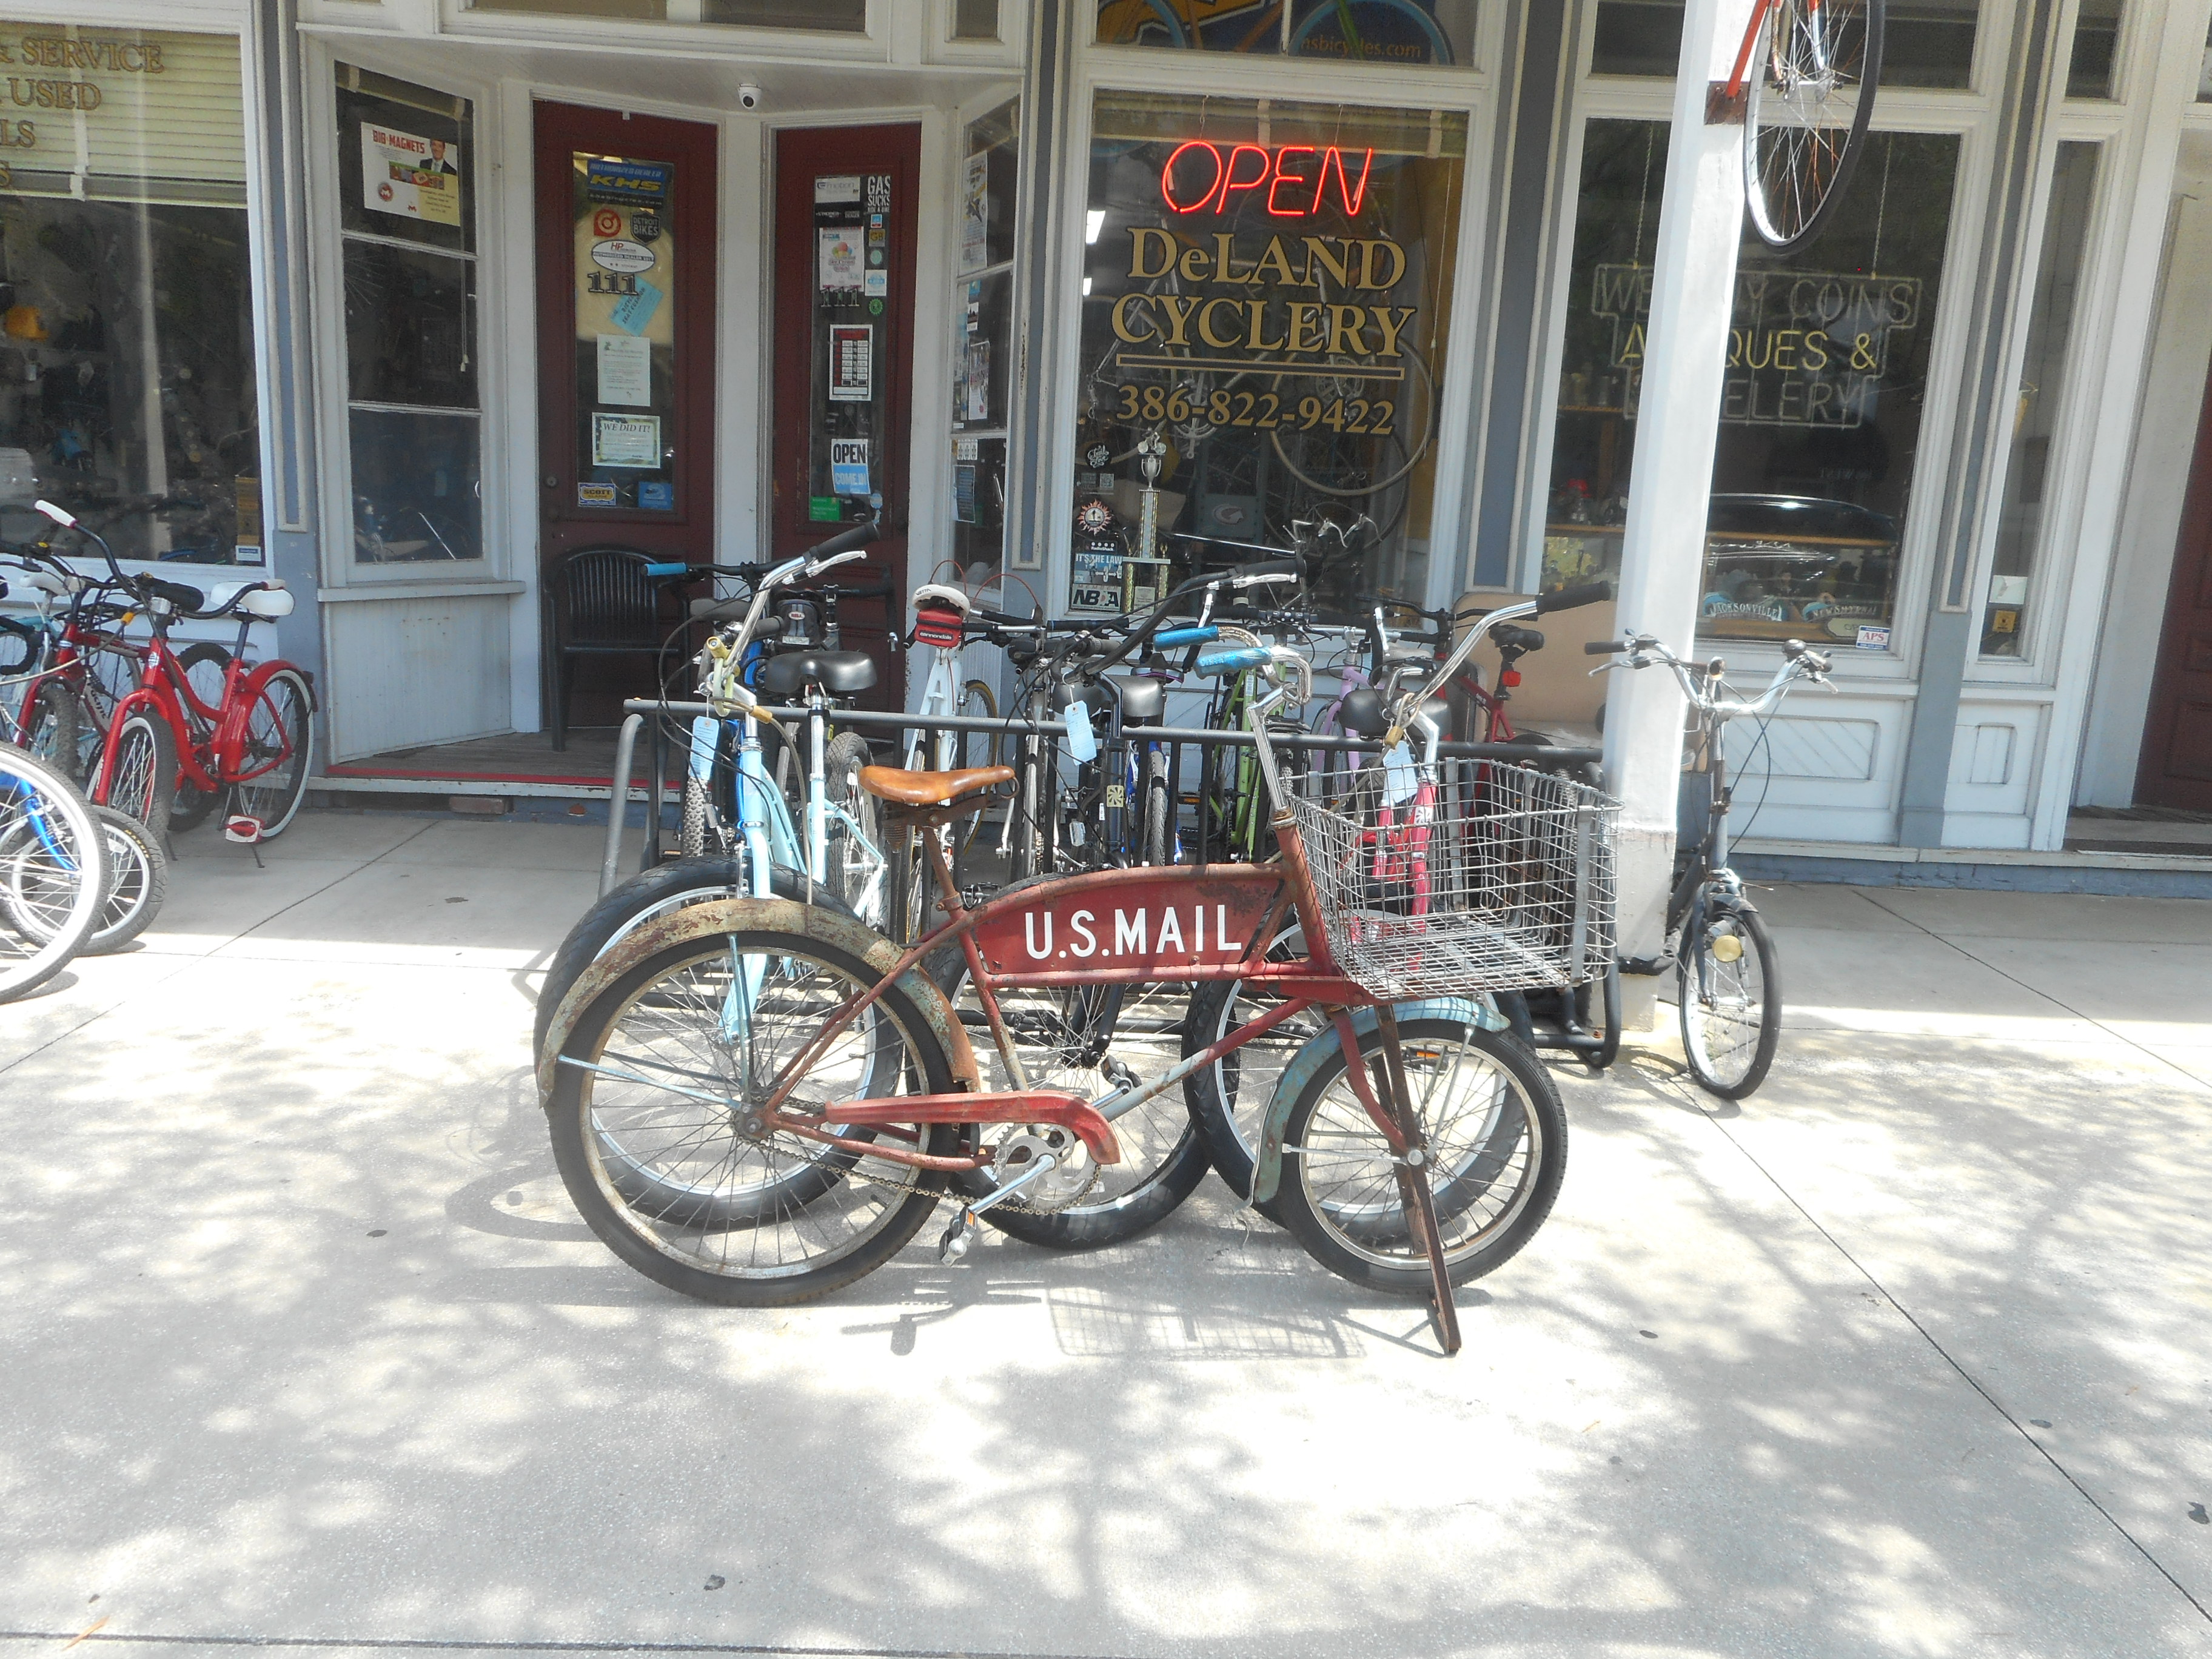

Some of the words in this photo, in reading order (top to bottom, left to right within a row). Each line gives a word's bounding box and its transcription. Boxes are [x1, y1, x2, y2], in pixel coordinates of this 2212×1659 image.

[22, 37, 165, 73] SERVICE
[7, 77, 102, 110] USED
[389, 133, 426, 154] MAGNETS
[590, 173, 662, 192] KHS
[634, 168, 662, 178] DEALER
[1161, 139, 1373, 216] OPEN
[867, 175, 891, 195] GAS
[867, 195, 890, 207] SUCKS
[632, 216, 659, 225] DETROIT
[632, 225, 659, 236] BIKES
[611, 242, 624, 250] HP
[1126, 226, 1407, 291] DeLAND
[587, 271, 639, 295] 111
[1788, 278, 1914, 325] COINS
[1110, 292, 1417, 358] CYCLERY
[1849, 333, 1877, 370] &
[1116, 384, 1395, 435] 386-822-9422
[603, 423, 618, 431] WE
[833, 443, 866, 464] OPEN
[834, 472, 856, 485] COME
[858, 473, 867, 485] IN
[1076, 554, 1089, 563] IT'S
[1091, 554, 1105, 563] THE
[1106, 555, 1122, 565] LAW
[1709, 602, 1779, 618] JACKSONVILLE
[919, 632, 952, 640] cannondale
[1863, 632, 1885, 642] APS
[1024, 904, 1242, 960] U.S.MAIL
